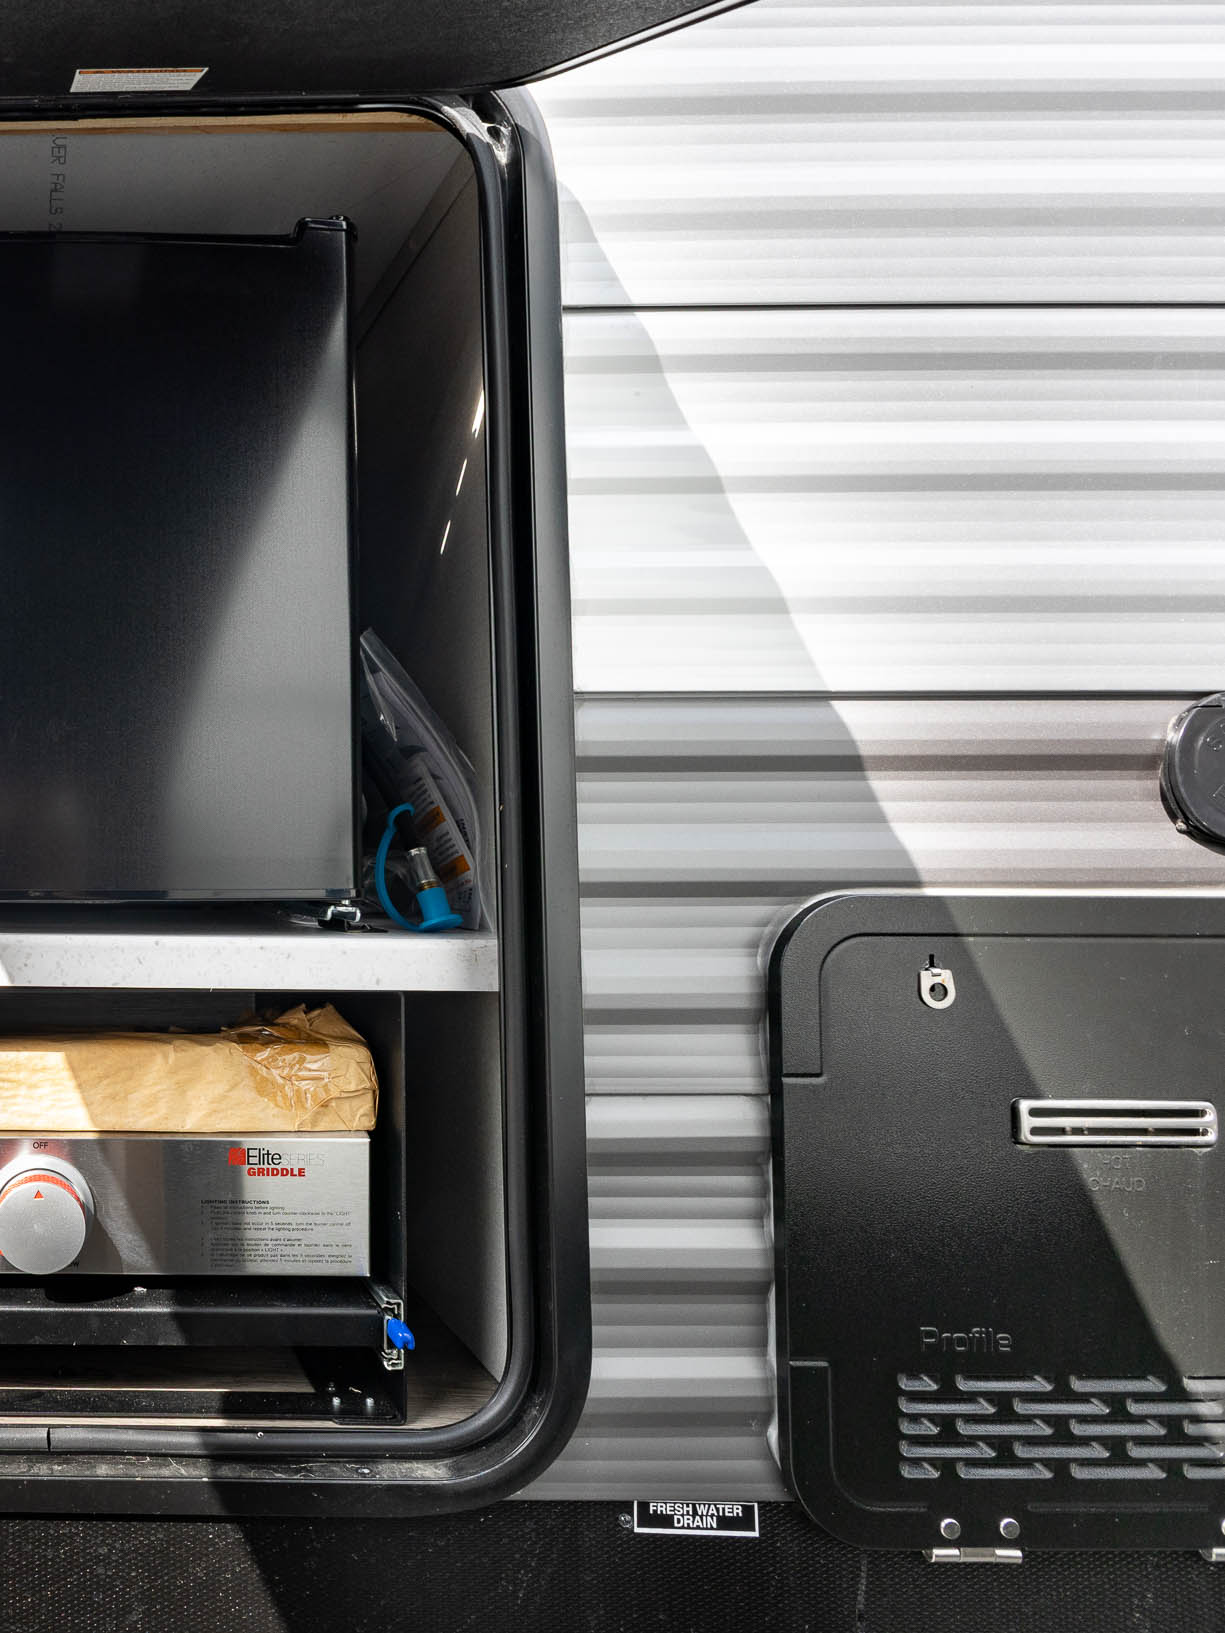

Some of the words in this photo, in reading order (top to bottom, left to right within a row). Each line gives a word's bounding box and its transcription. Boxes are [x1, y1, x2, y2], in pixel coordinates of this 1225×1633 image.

[50, 135, 68, 165] VER
[49, 173, 66, 215] FALLS
[32, 1141, 49, 1150] OFF
[247, 1147, 282, 1166] Elite
[1102, 1154, 1130, 1168] HOT
[247, 1167, 306, 1177] GRIDDLE
[1090, 1177, 1146, 1192] CHAUD
[920, 1326, 1013, 1353] Profile
[649, 1502, 692, 1516] FRESH
[695, 1503, 743, 1517] WATER
[674, 1515, 717, 1529] DRAIN
